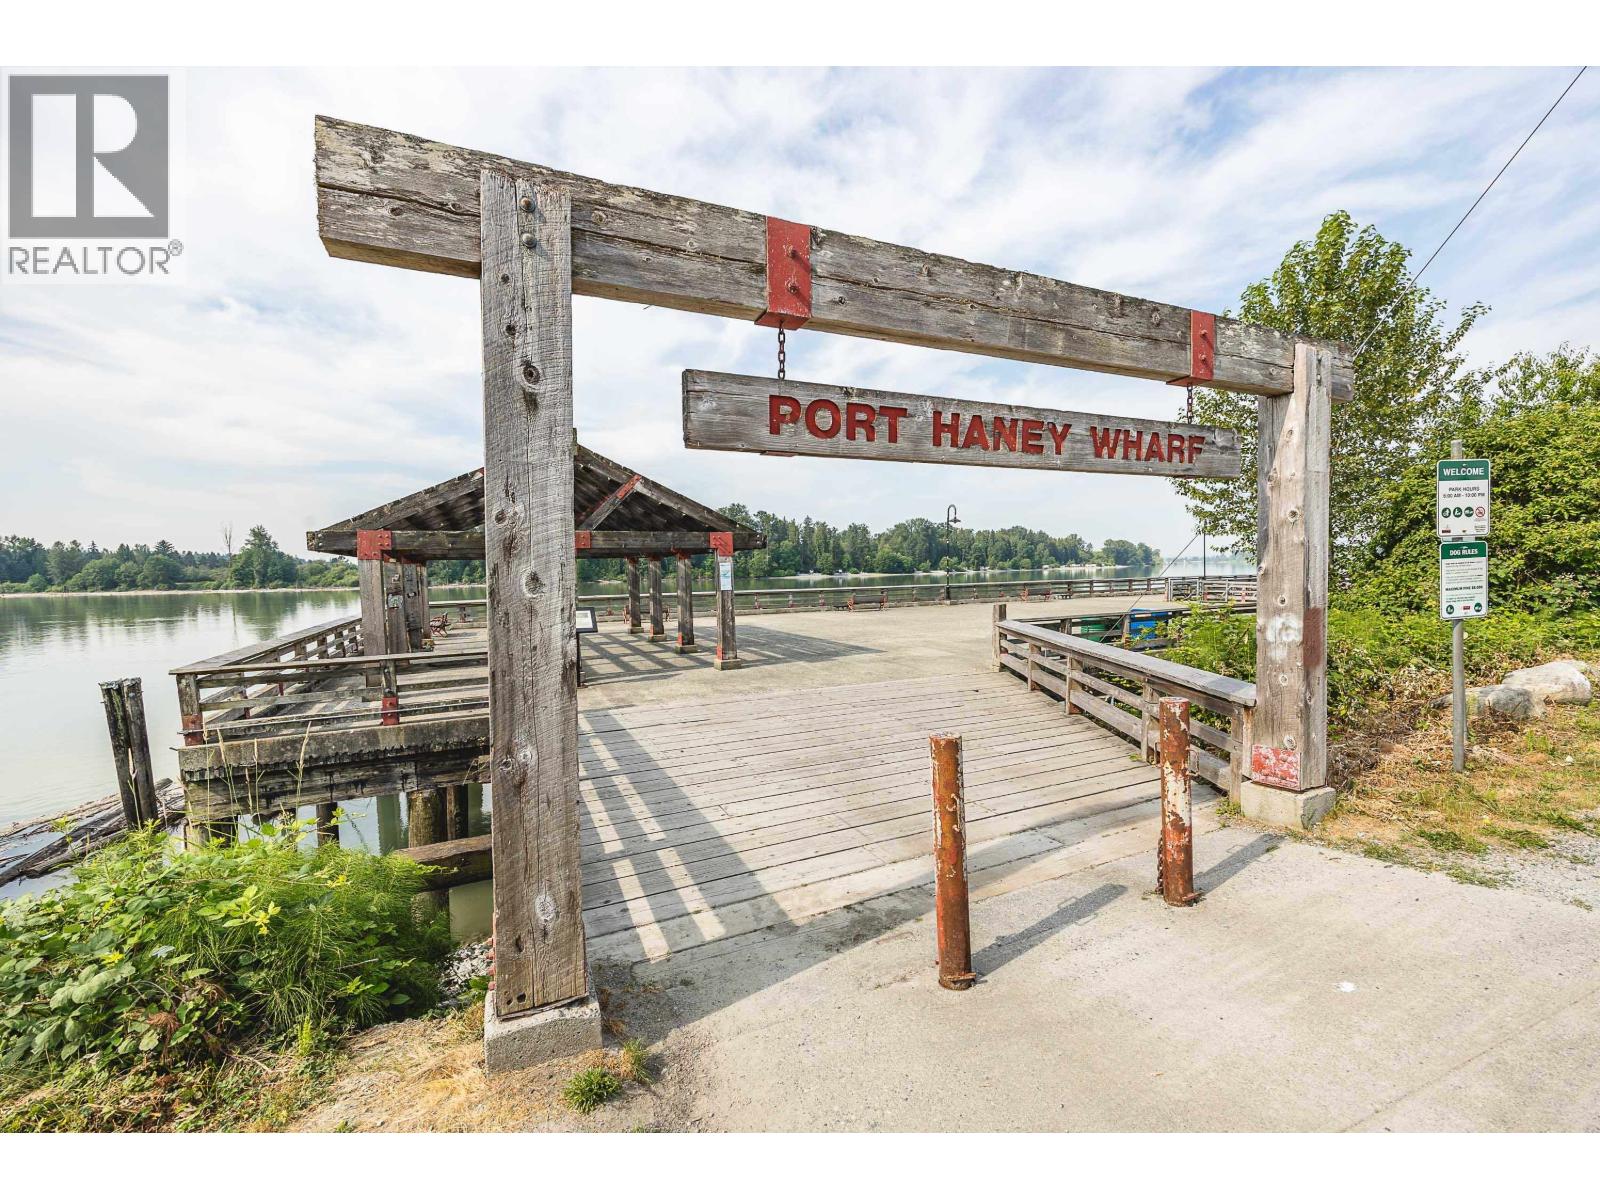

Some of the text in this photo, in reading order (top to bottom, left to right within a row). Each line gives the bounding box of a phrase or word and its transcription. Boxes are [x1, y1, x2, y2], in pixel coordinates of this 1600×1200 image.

[768, 394, 1206, 465] PORT HANEY WHARF
[1443, 467, 1485, 476] WELCOME
